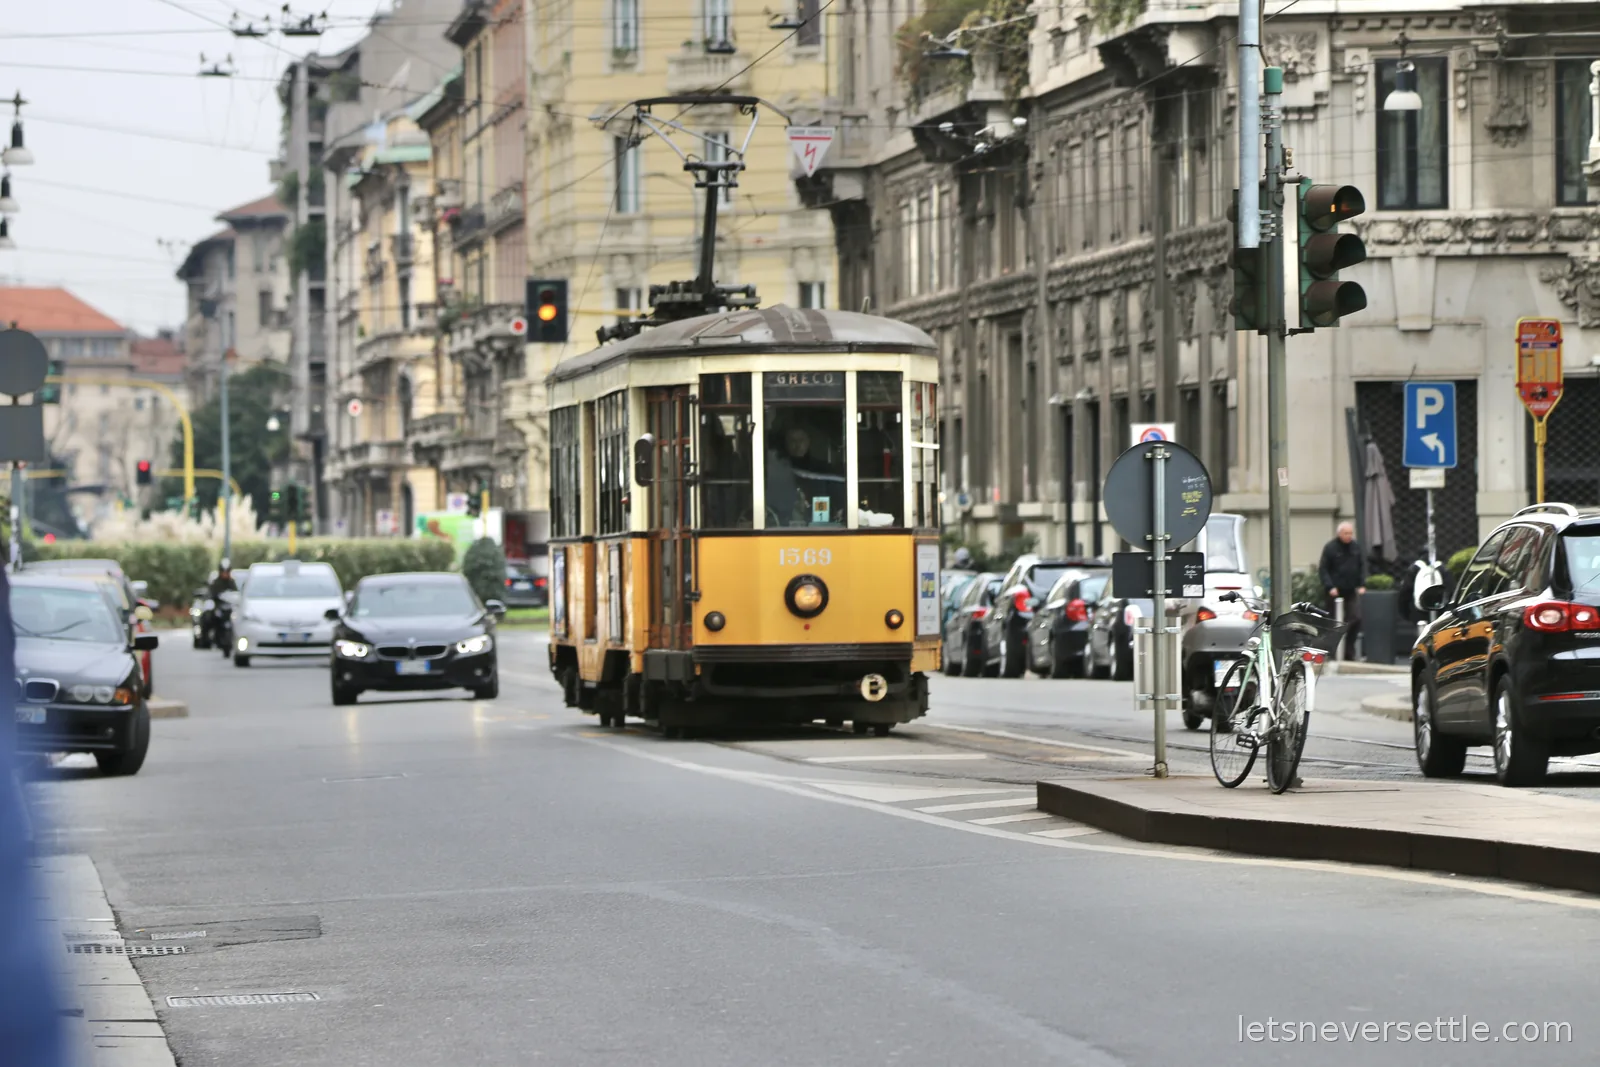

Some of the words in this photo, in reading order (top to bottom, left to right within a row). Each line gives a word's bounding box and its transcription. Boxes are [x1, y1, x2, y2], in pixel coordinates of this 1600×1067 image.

[777, 373, 833, 384] GRECO
[1416, 388, 1444, 429] P
[779, 547, 832, 566] 1569
